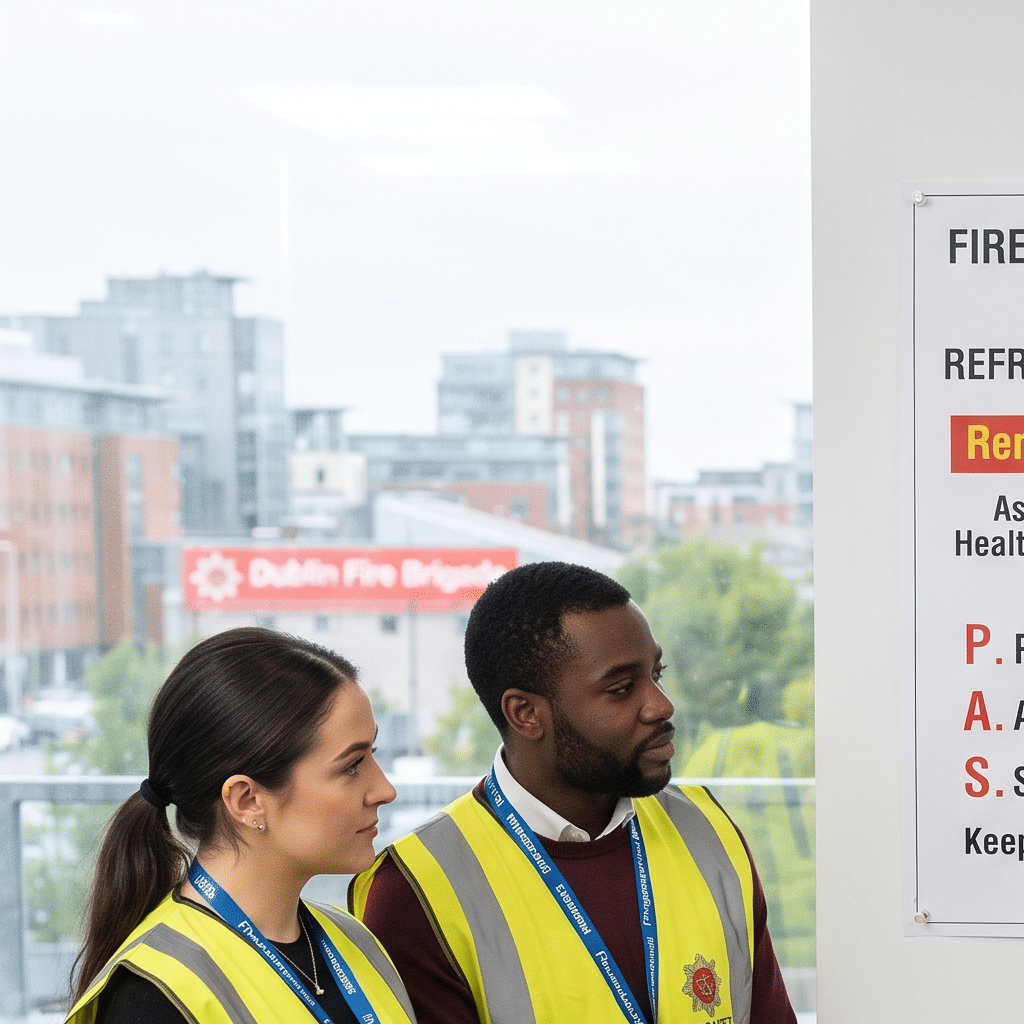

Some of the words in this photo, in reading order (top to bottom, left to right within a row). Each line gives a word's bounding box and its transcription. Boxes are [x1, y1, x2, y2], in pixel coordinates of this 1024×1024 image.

[994, 496, 1024, 521] As
[248, 557, 340, 588] Dublin
[342, 557, 398, 588] Fire
[966, 624, 1002, 664] P.
[964, 691, 1002, 730] A.
[966, 756, 1002, 797] S.
